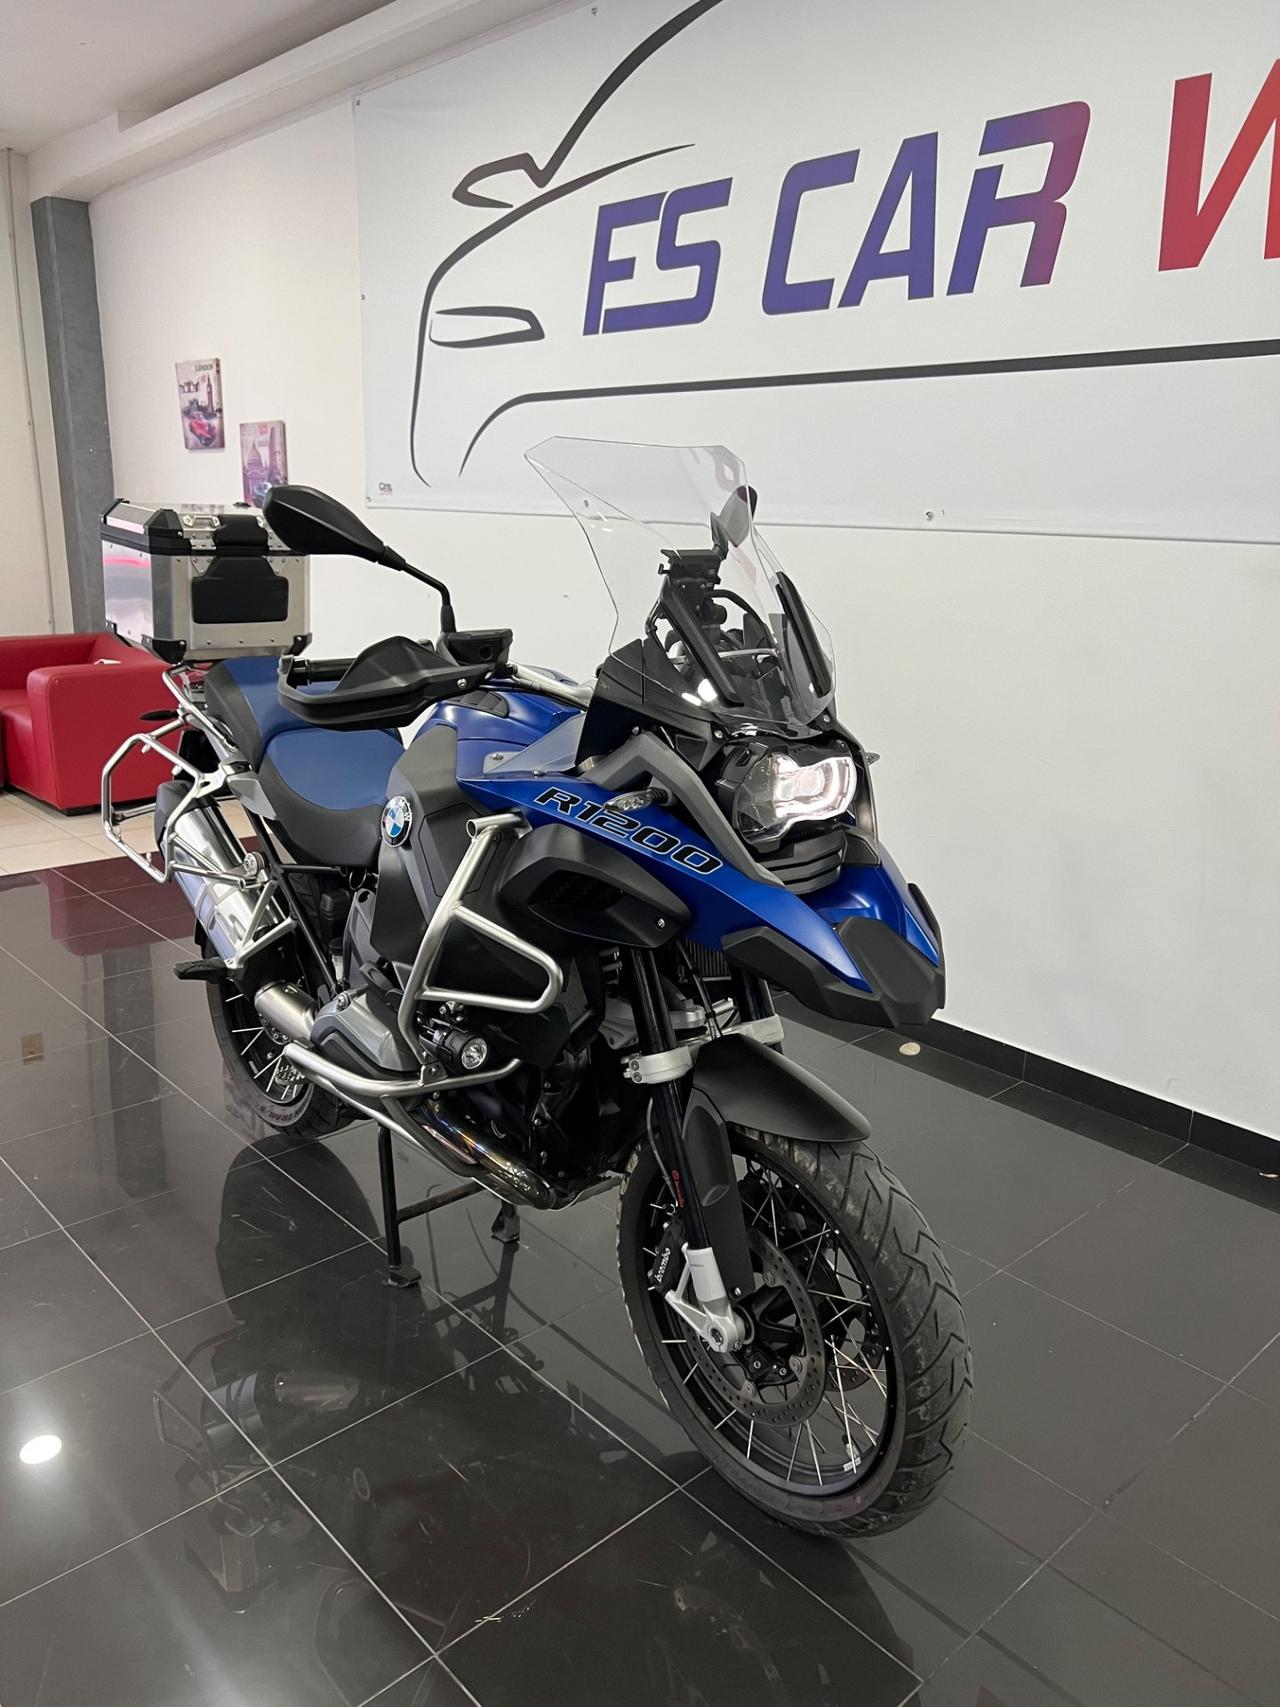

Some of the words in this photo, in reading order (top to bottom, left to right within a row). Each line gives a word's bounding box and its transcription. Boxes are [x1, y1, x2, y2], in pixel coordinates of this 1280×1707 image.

[582, 177, 733, 337] ES
[761, 100, 1091, 316] CAR
[535, 786, 724, 875] R1200
[654, 1247, 671, 1283] brembo
